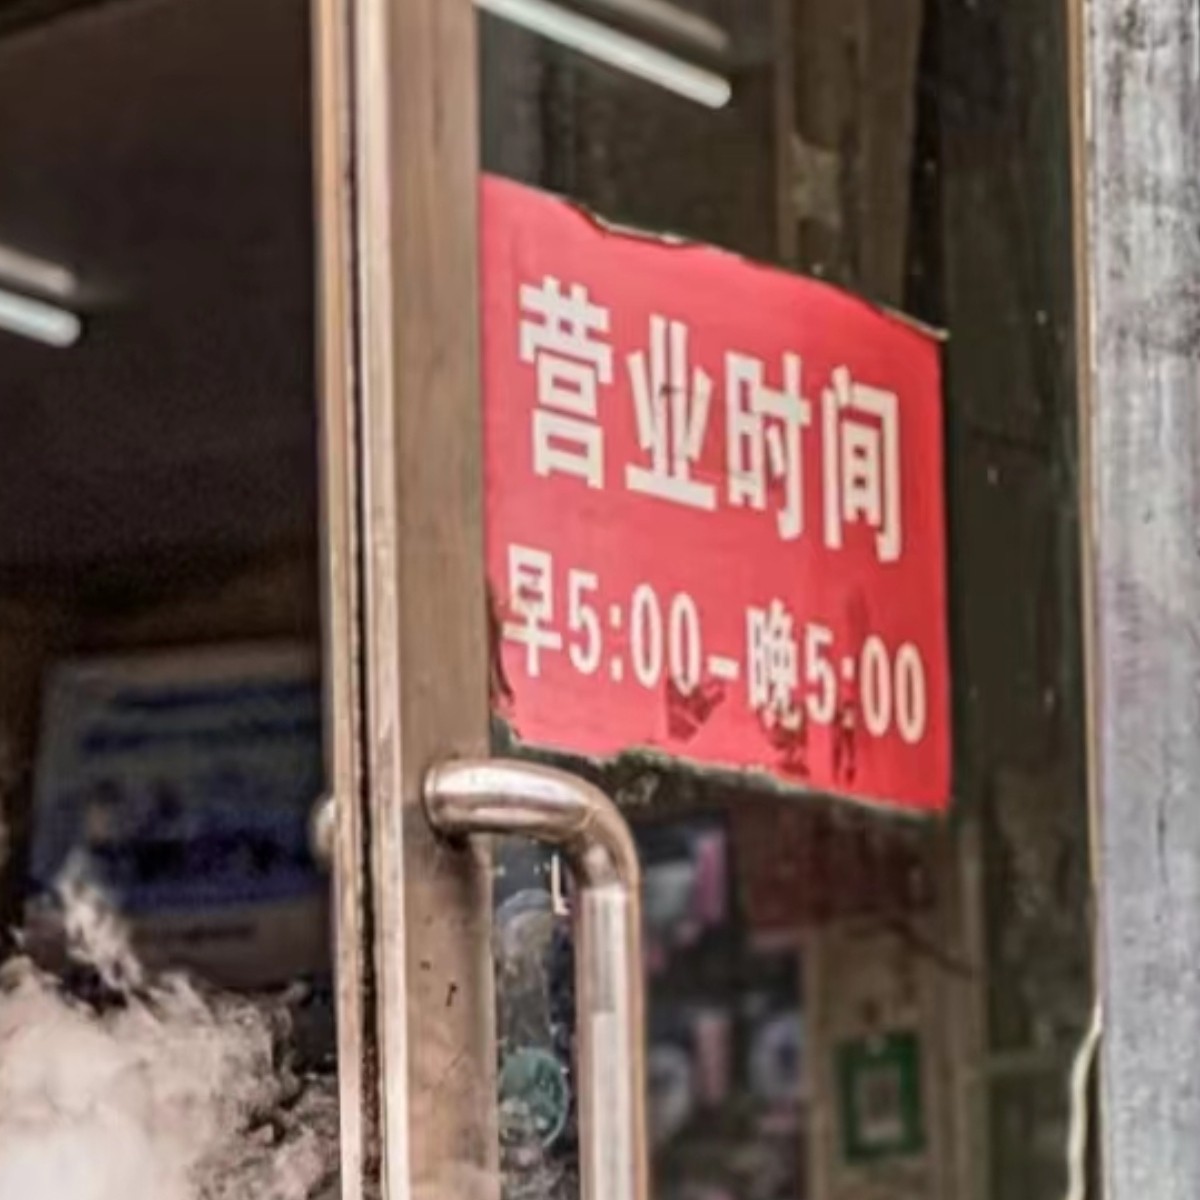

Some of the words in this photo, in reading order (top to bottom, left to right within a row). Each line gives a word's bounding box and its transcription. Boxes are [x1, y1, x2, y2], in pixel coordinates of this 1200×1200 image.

[518, 275, 901, 562] 营业时间
[501, 543, 926, 743] 早5:00-晚5:00
